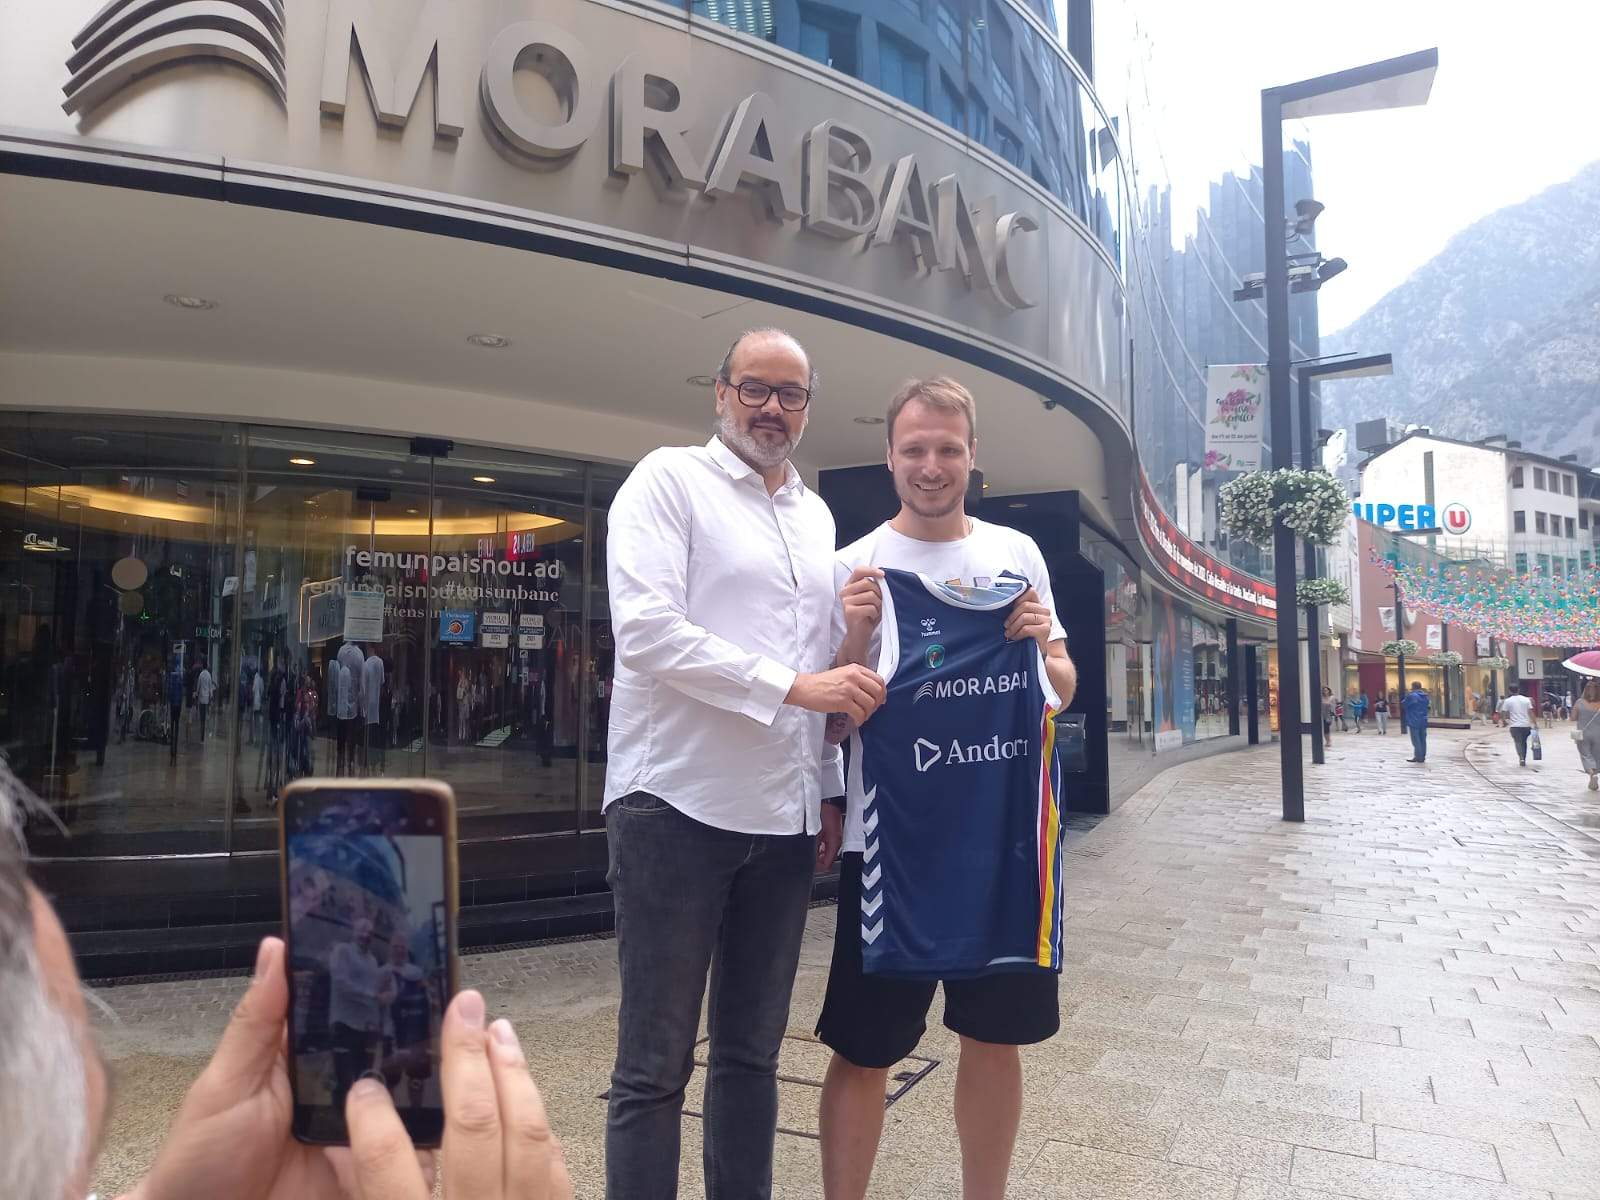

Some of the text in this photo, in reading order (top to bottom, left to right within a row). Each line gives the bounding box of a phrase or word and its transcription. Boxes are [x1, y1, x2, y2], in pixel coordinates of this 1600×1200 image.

[318, 0, 1040, 311] MORABANC
[1353, 503, 1467, 530] UPER U
[345, 545, 561, 579] femunpaisnou.ad
[444, 581, 559, 602] #tensunbanc
[935, 670, 1028, 699] MORABAN
[945, 734, 1029, 765] Andor
